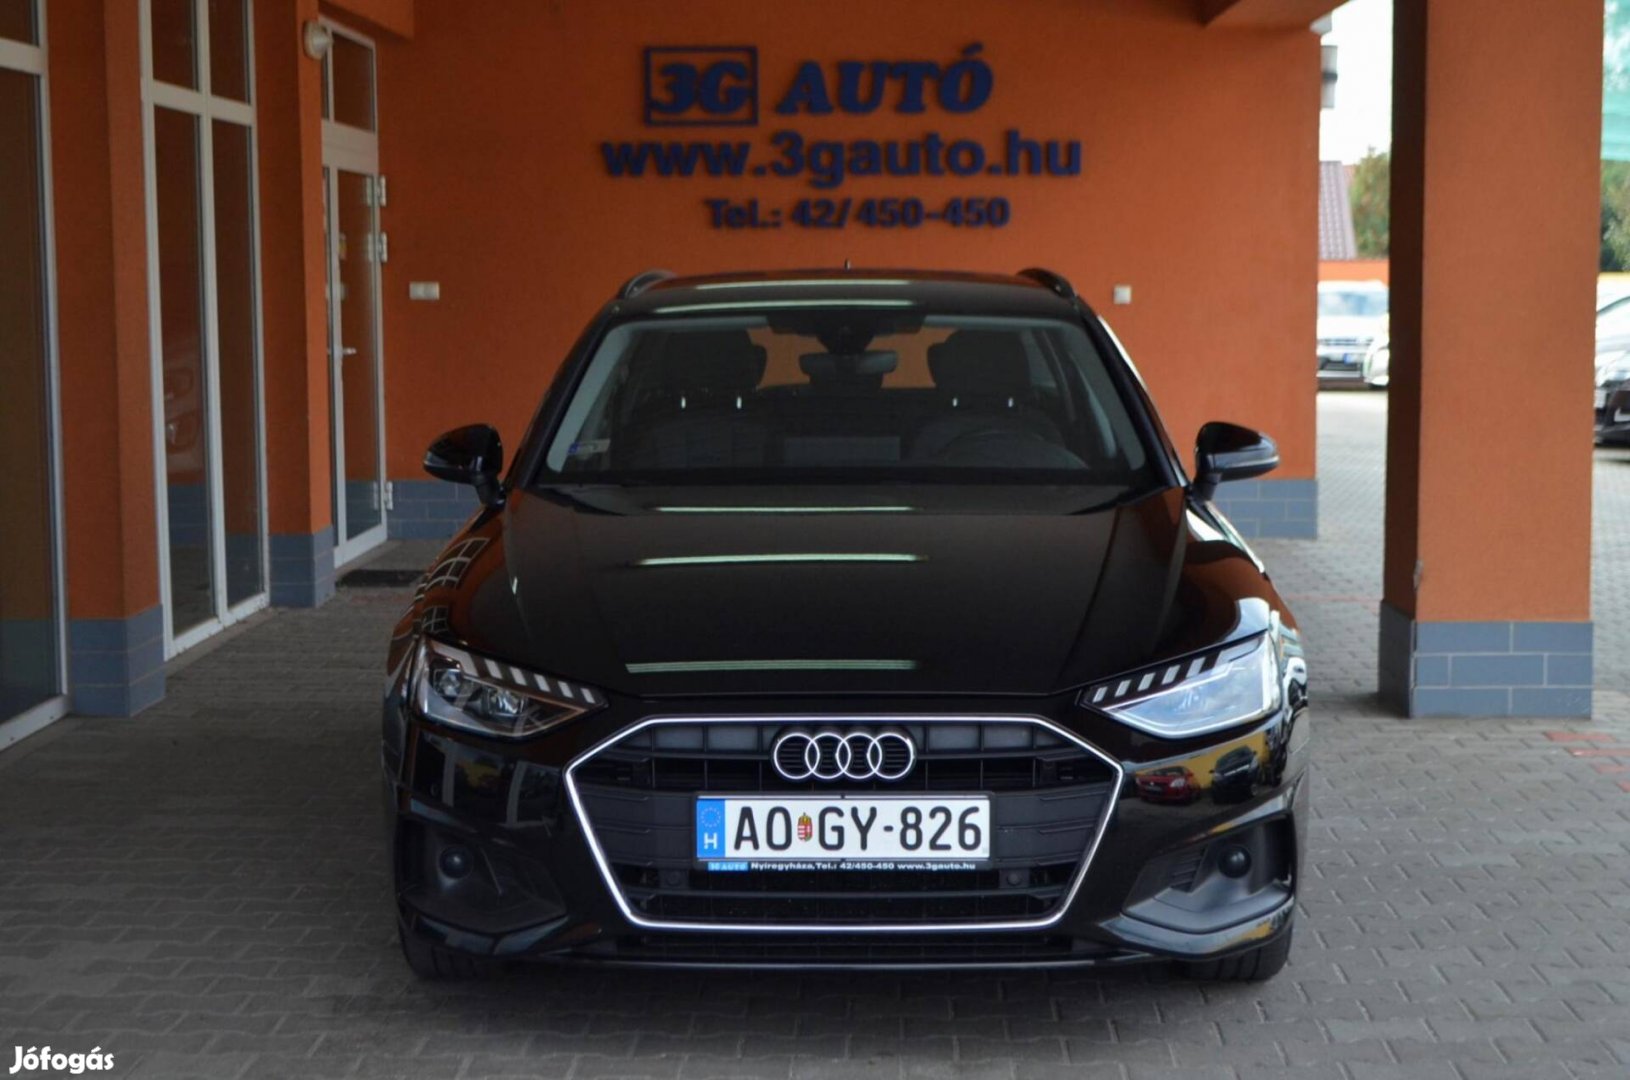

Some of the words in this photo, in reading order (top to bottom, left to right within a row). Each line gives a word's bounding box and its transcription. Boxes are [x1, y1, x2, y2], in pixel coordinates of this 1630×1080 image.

[650, 60, 755, 115] 3G
[775, 42, 994, 115] AUTÓ
[601, 129, 1082, 188] www.3gauto.hu
[704, 198, 782, 229] Tel.:
[703, 833, 718, 849] H
[734, 806, 792, 850] AO
[818, 806, 981, 850] GY-826
